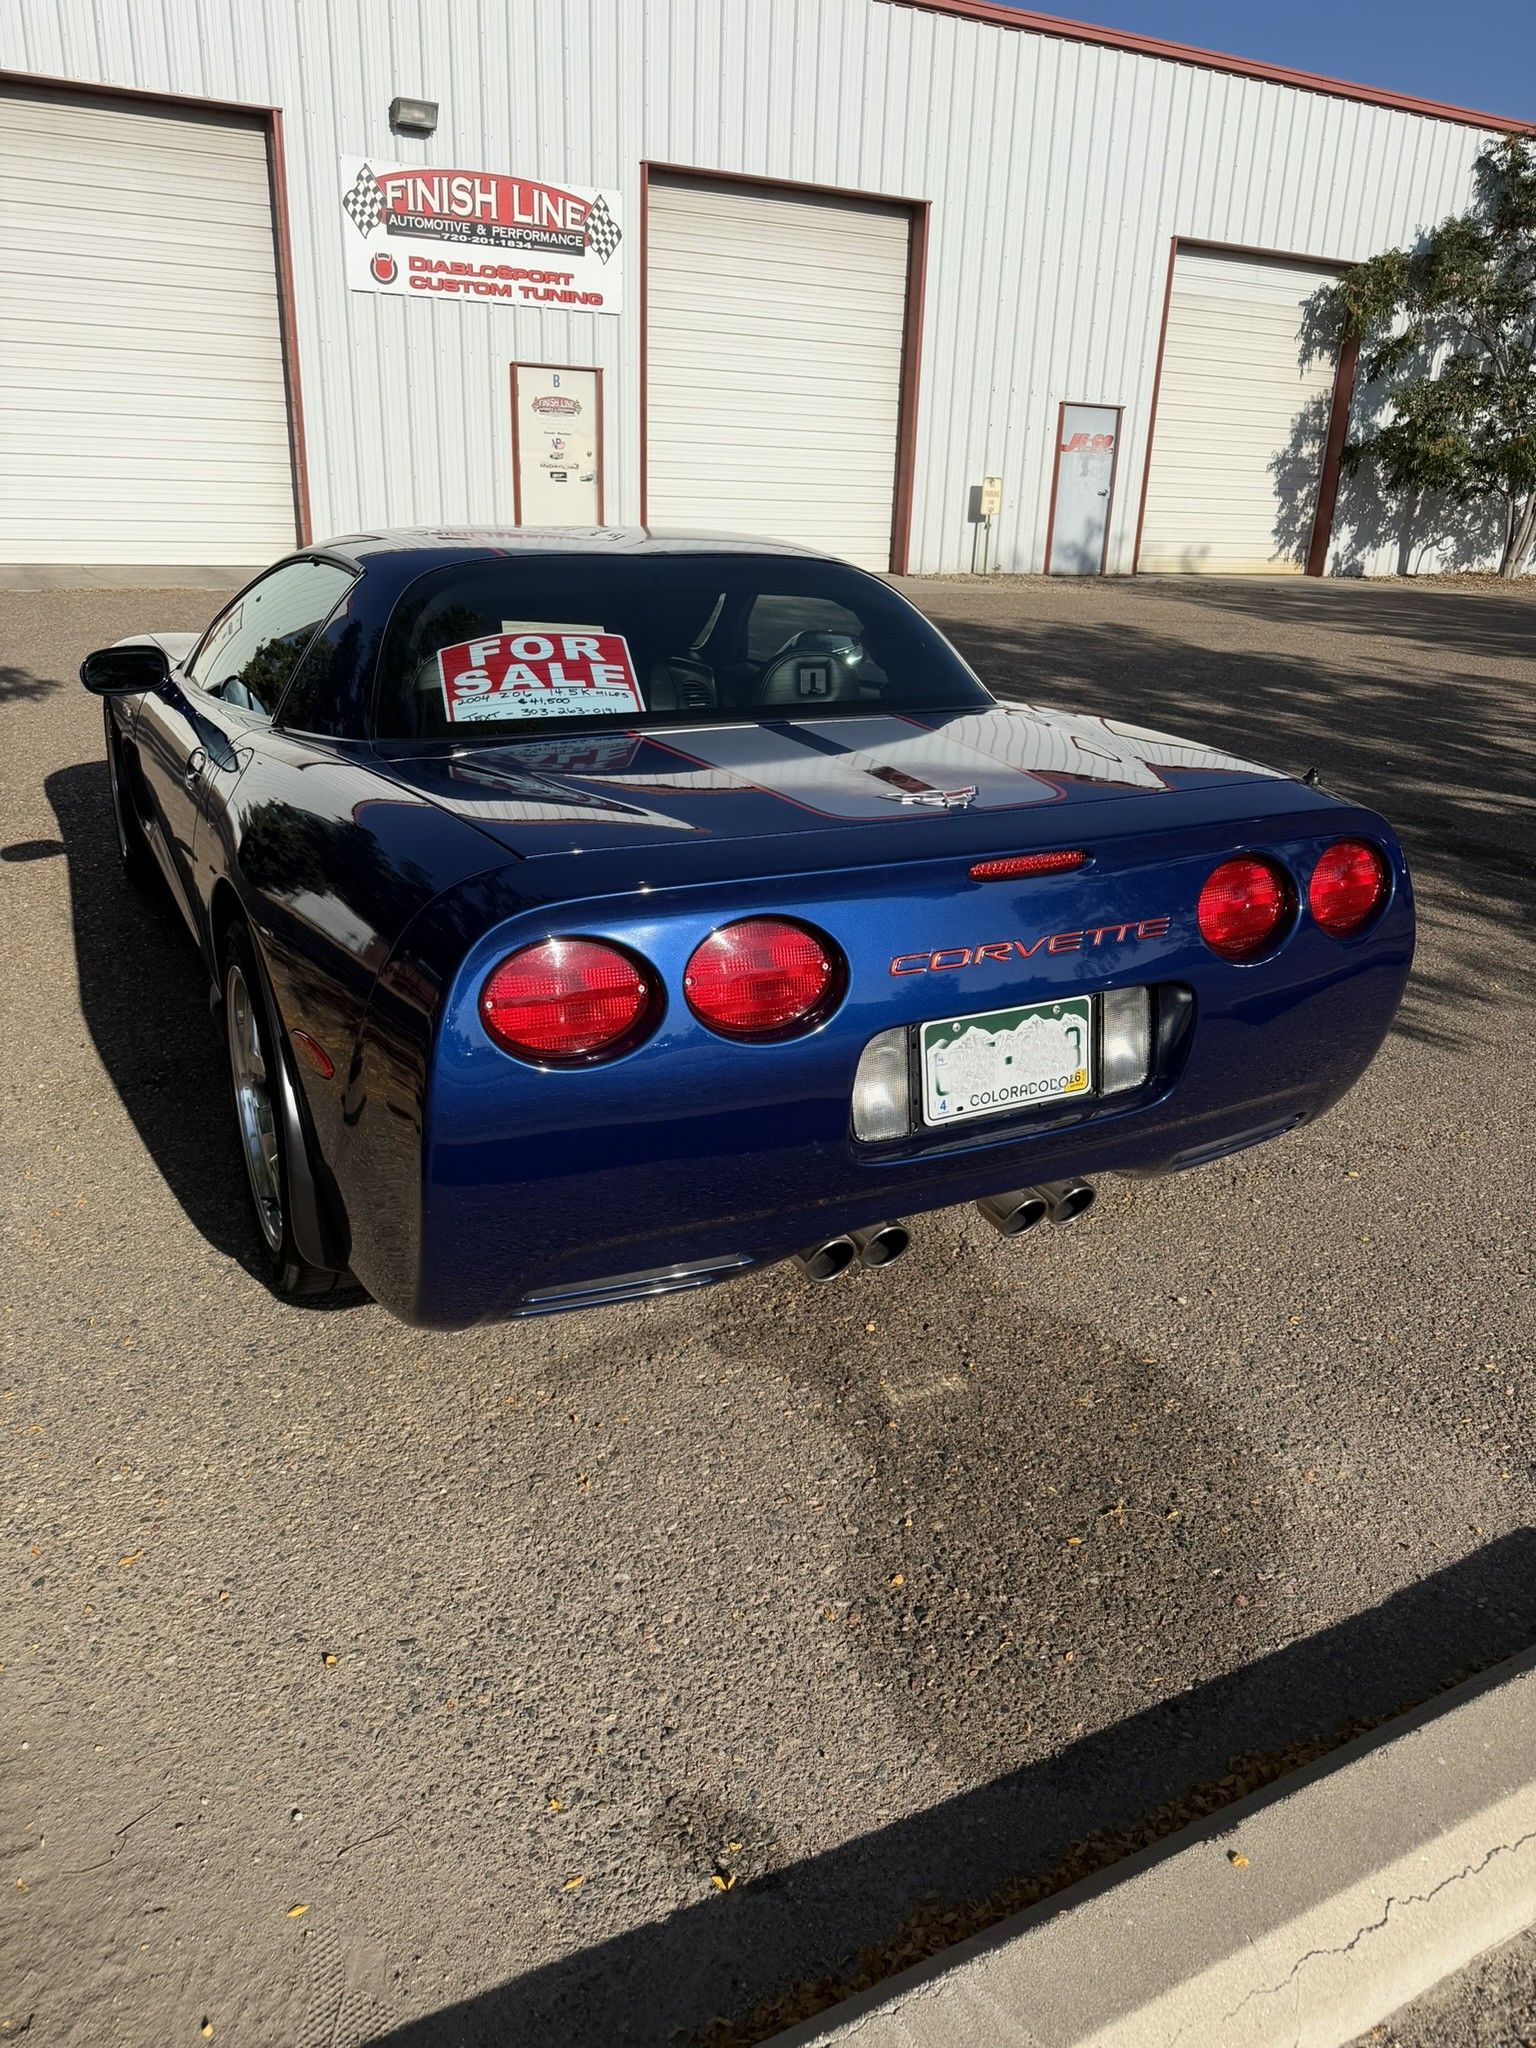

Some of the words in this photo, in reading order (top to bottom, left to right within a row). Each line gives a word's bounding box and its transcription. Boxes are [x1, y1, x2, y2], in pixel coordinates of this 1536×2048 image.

[385, 176, 499, 219] FINISH
[513, 184, 586, 231] LINE
[388, 214, 471, 234] AUTOMOTIVE
[476, 224, 487, 236] &
[491, 225, 584, 247] PERFORMANCE
[409, 275, 512, 297] CUSTOM
[518, 285, 604, 306] TUNING
[553, 374, 560, 388] B
[469, 635, 606, 668] FOR
[454, 662, 629, 697] SALE
[457, 695, 490, 706] 2004
[889, 916, 1170, 977] CORVETTE
